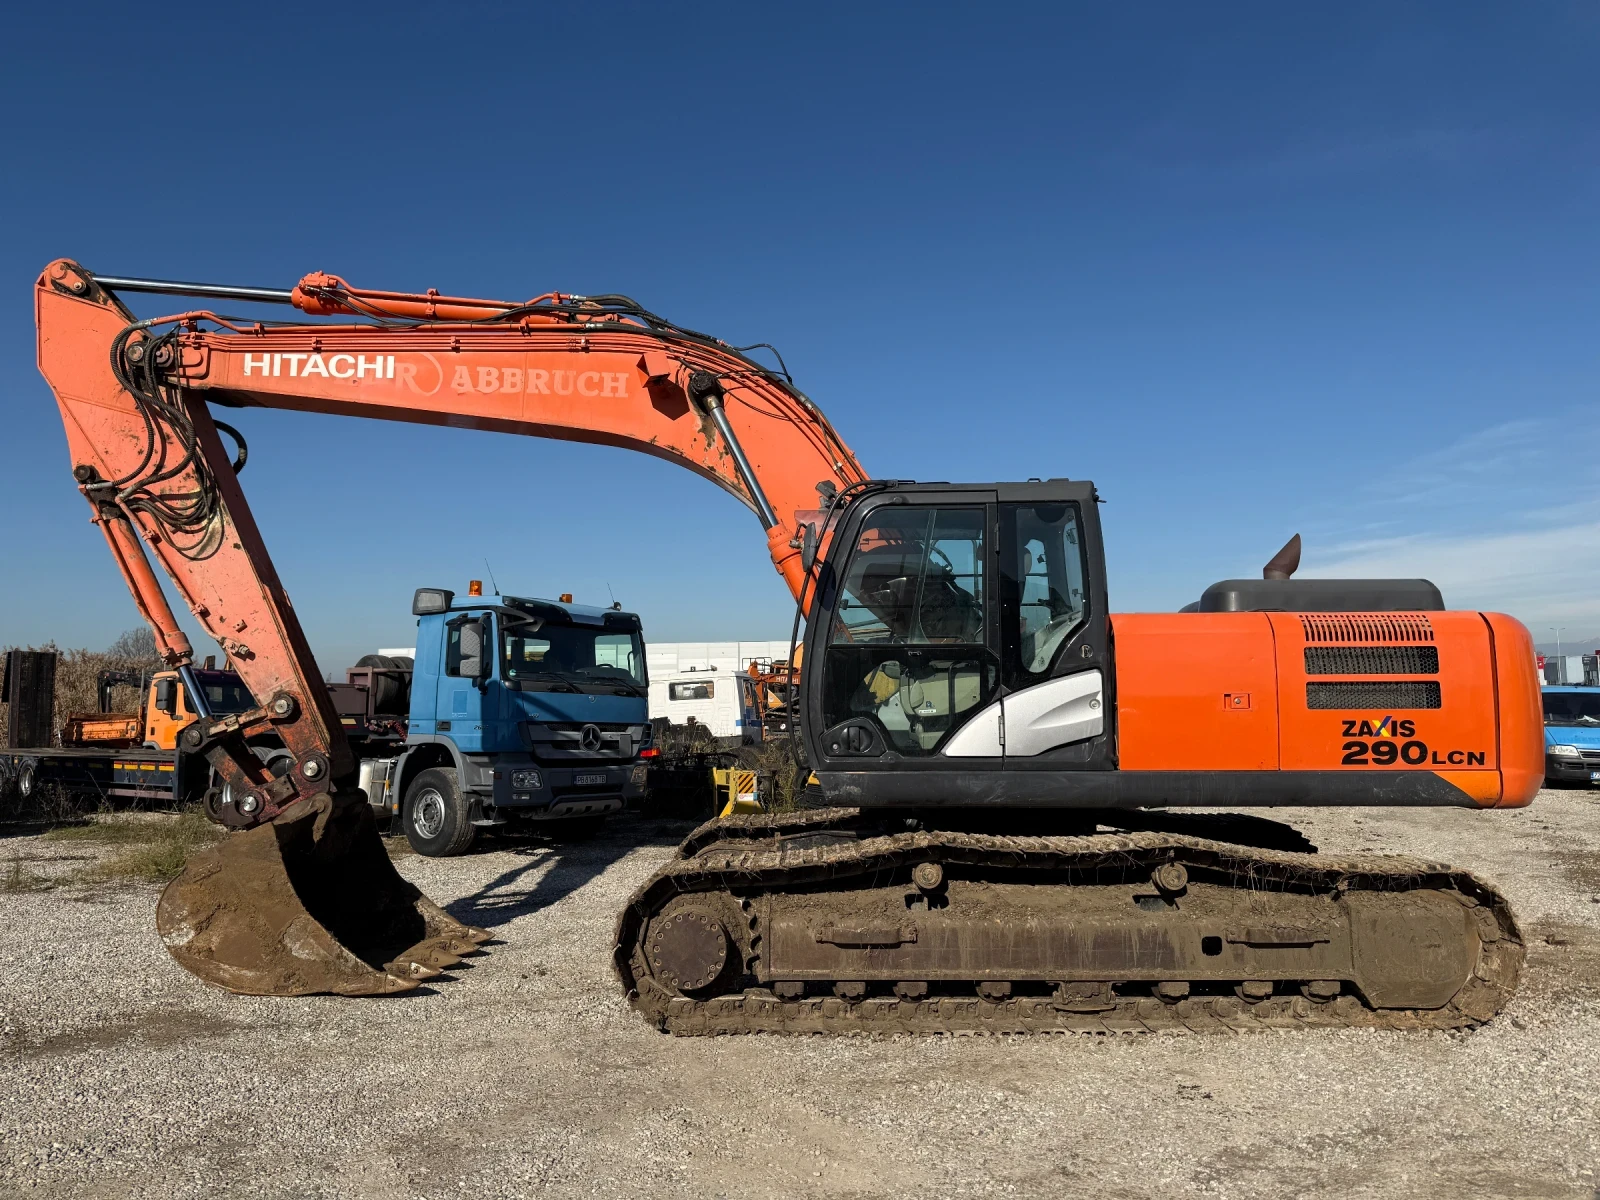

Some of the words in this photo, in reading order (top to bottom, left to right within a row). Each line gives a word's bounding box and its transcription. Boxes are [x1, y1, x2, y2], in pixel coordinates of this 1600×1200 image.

[243, 353, 395, 379] HITACHI
[450, 365, 629, 398] ABBRUCH
[775, 676, 799, 684] HITAHI
[1341, 715, 1416, 738] ZAXIS
